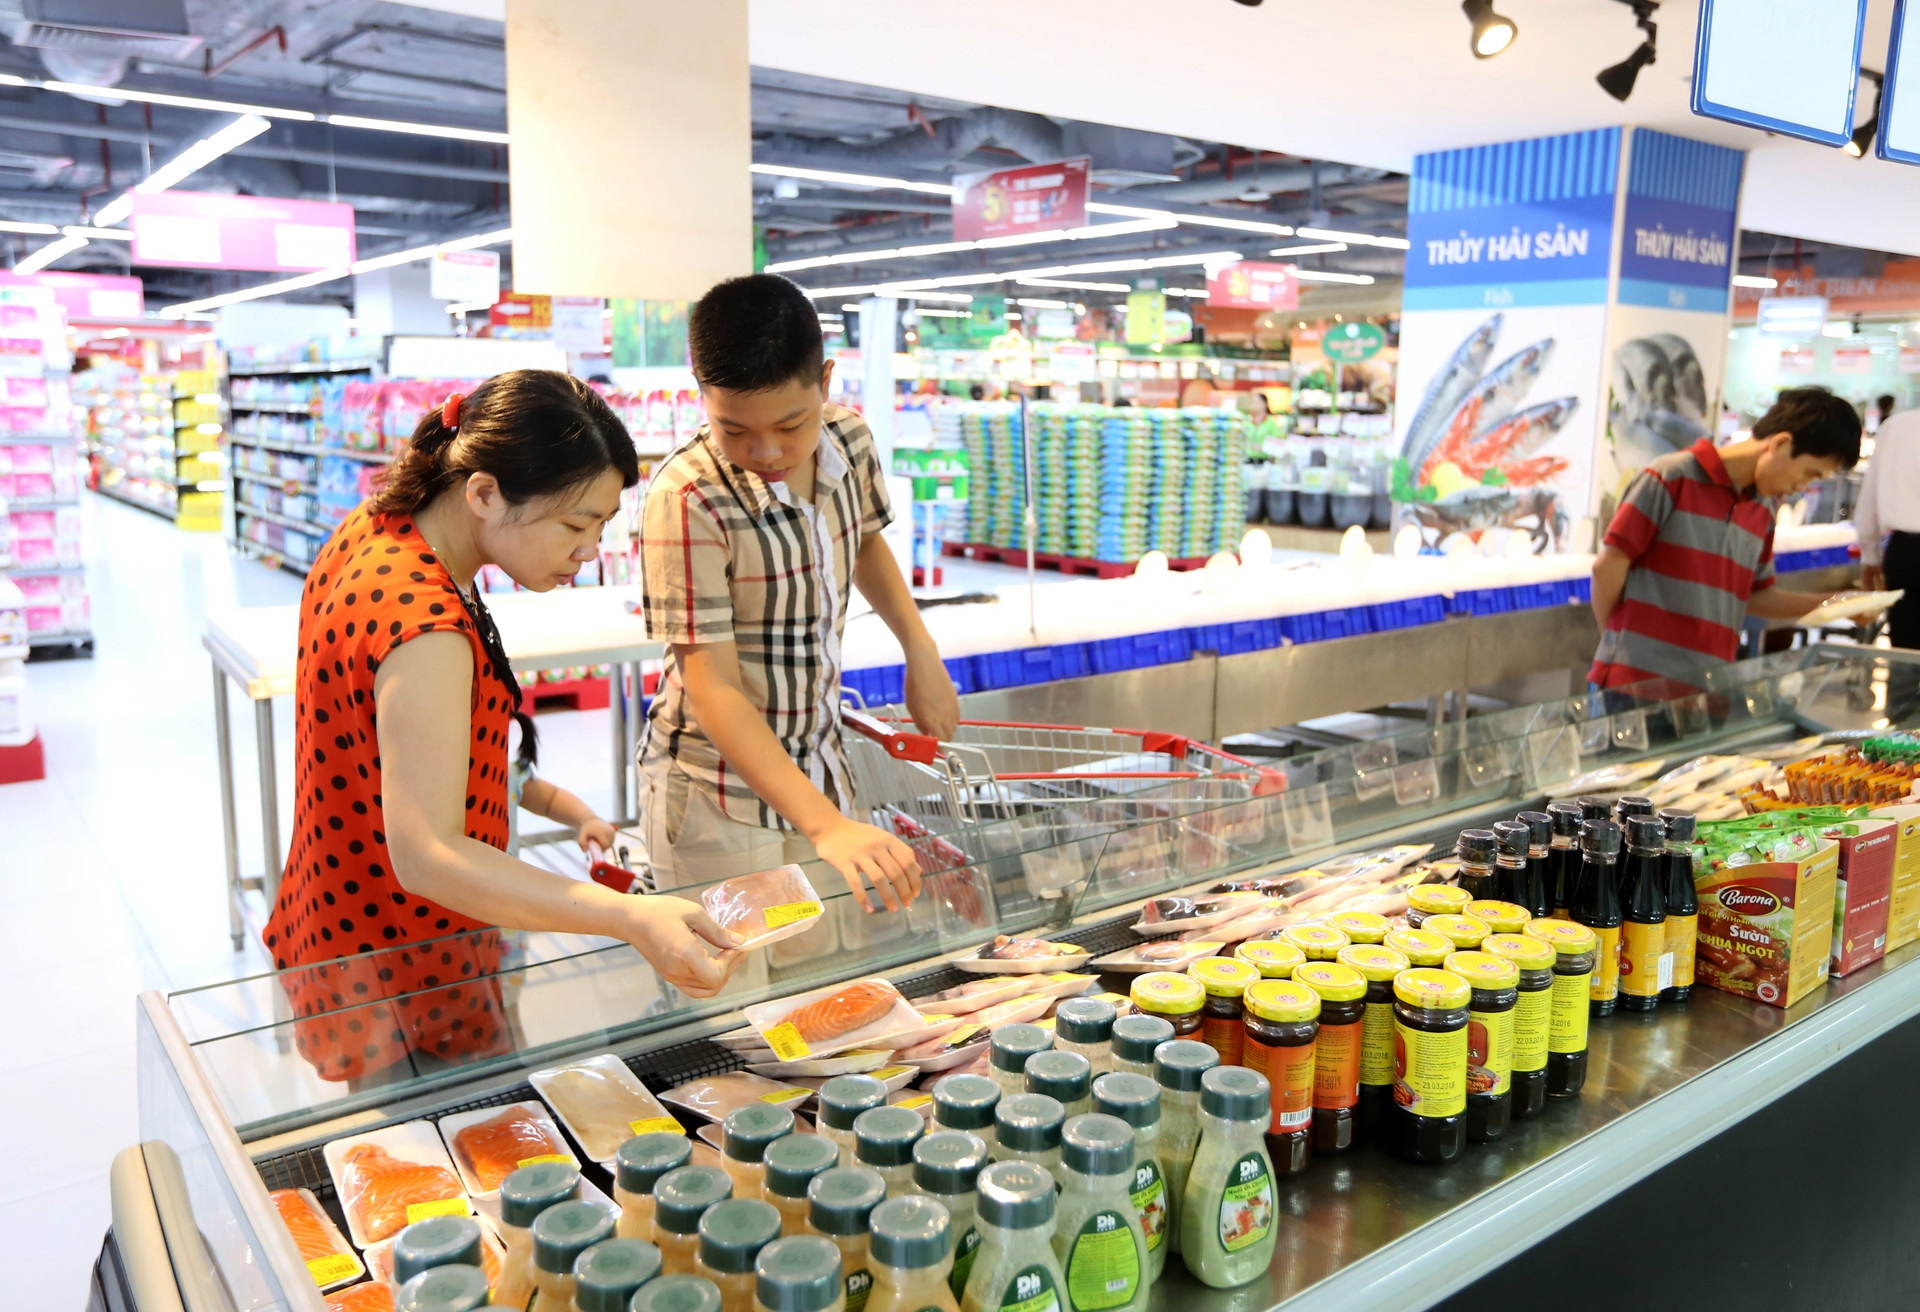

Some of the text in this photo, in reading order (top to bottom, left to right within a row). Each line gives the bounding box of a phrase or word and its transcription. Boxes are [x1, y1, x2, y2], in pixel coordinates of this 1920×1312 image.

[1427, 222, 1589, 265] THỦY HẢI SẢN
[1635, 222, 1727, 266] THỦY HẢI SẢN
[1720, 889, 1774, 907] Barona
[1729, 924, 1771, 945] Sườn
[1699, 932, 1776, 959] CHUA NGỌT
[1136, 1165, 1154, 1184] Dh
[1239, 1159, 1259, 1177] Dh
[1096, 1214, 1116, 1228] Dh
[848, 1273, 870, 1291] Dh
[1016, 1272, 1041, 1294] Dh
